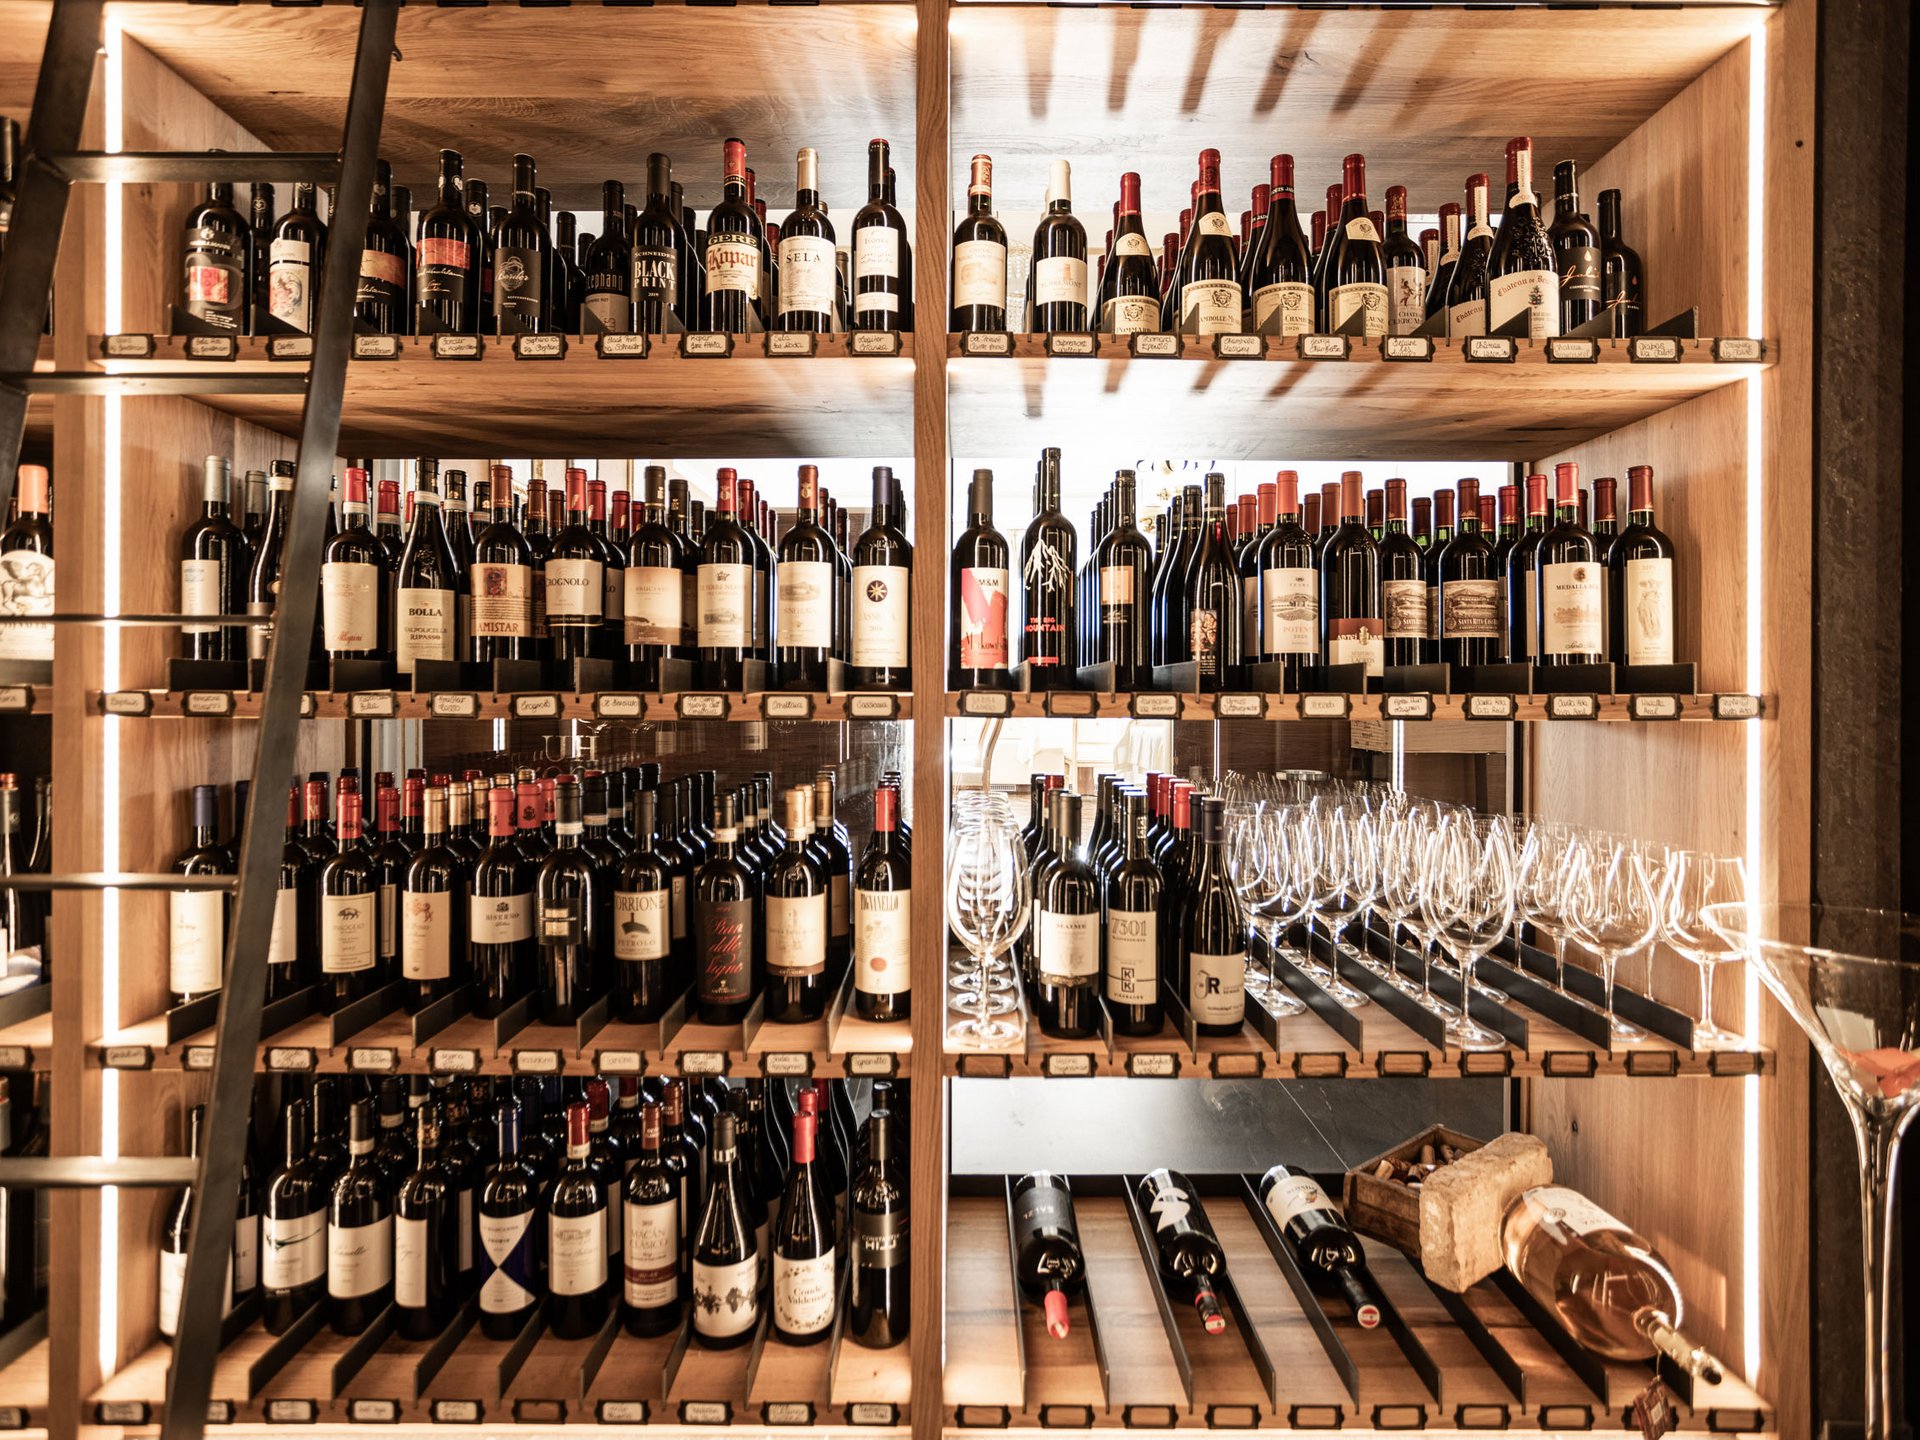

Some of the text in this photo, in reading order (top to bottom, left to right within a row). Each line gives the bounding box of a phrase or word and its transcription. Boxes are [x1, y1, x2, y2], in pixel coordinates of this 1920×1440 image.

[707, 234, 758, 248] GERE
[634, 250, 677, 259] SCHNEIDER
[707, 248, 757, 272] Kopar
[786, 252, 822, 264] SELA
[634, 260, 676, 281] BLACK
[634, 276, 677, 291] PRINT
[978, 578, 1000, 587] M&M
[1556, 583, 1588, 591] MEDALLA
[408, 607, 443, 618] BOLLA
[478, 622, 519, 633] AMISTAR
[1111, 916, 1148, 937] 7301
[1124, 970, 1132, 979] K
[1124, 981, 1132, 990] K
[792, 1286, 823, 1296] Conde
